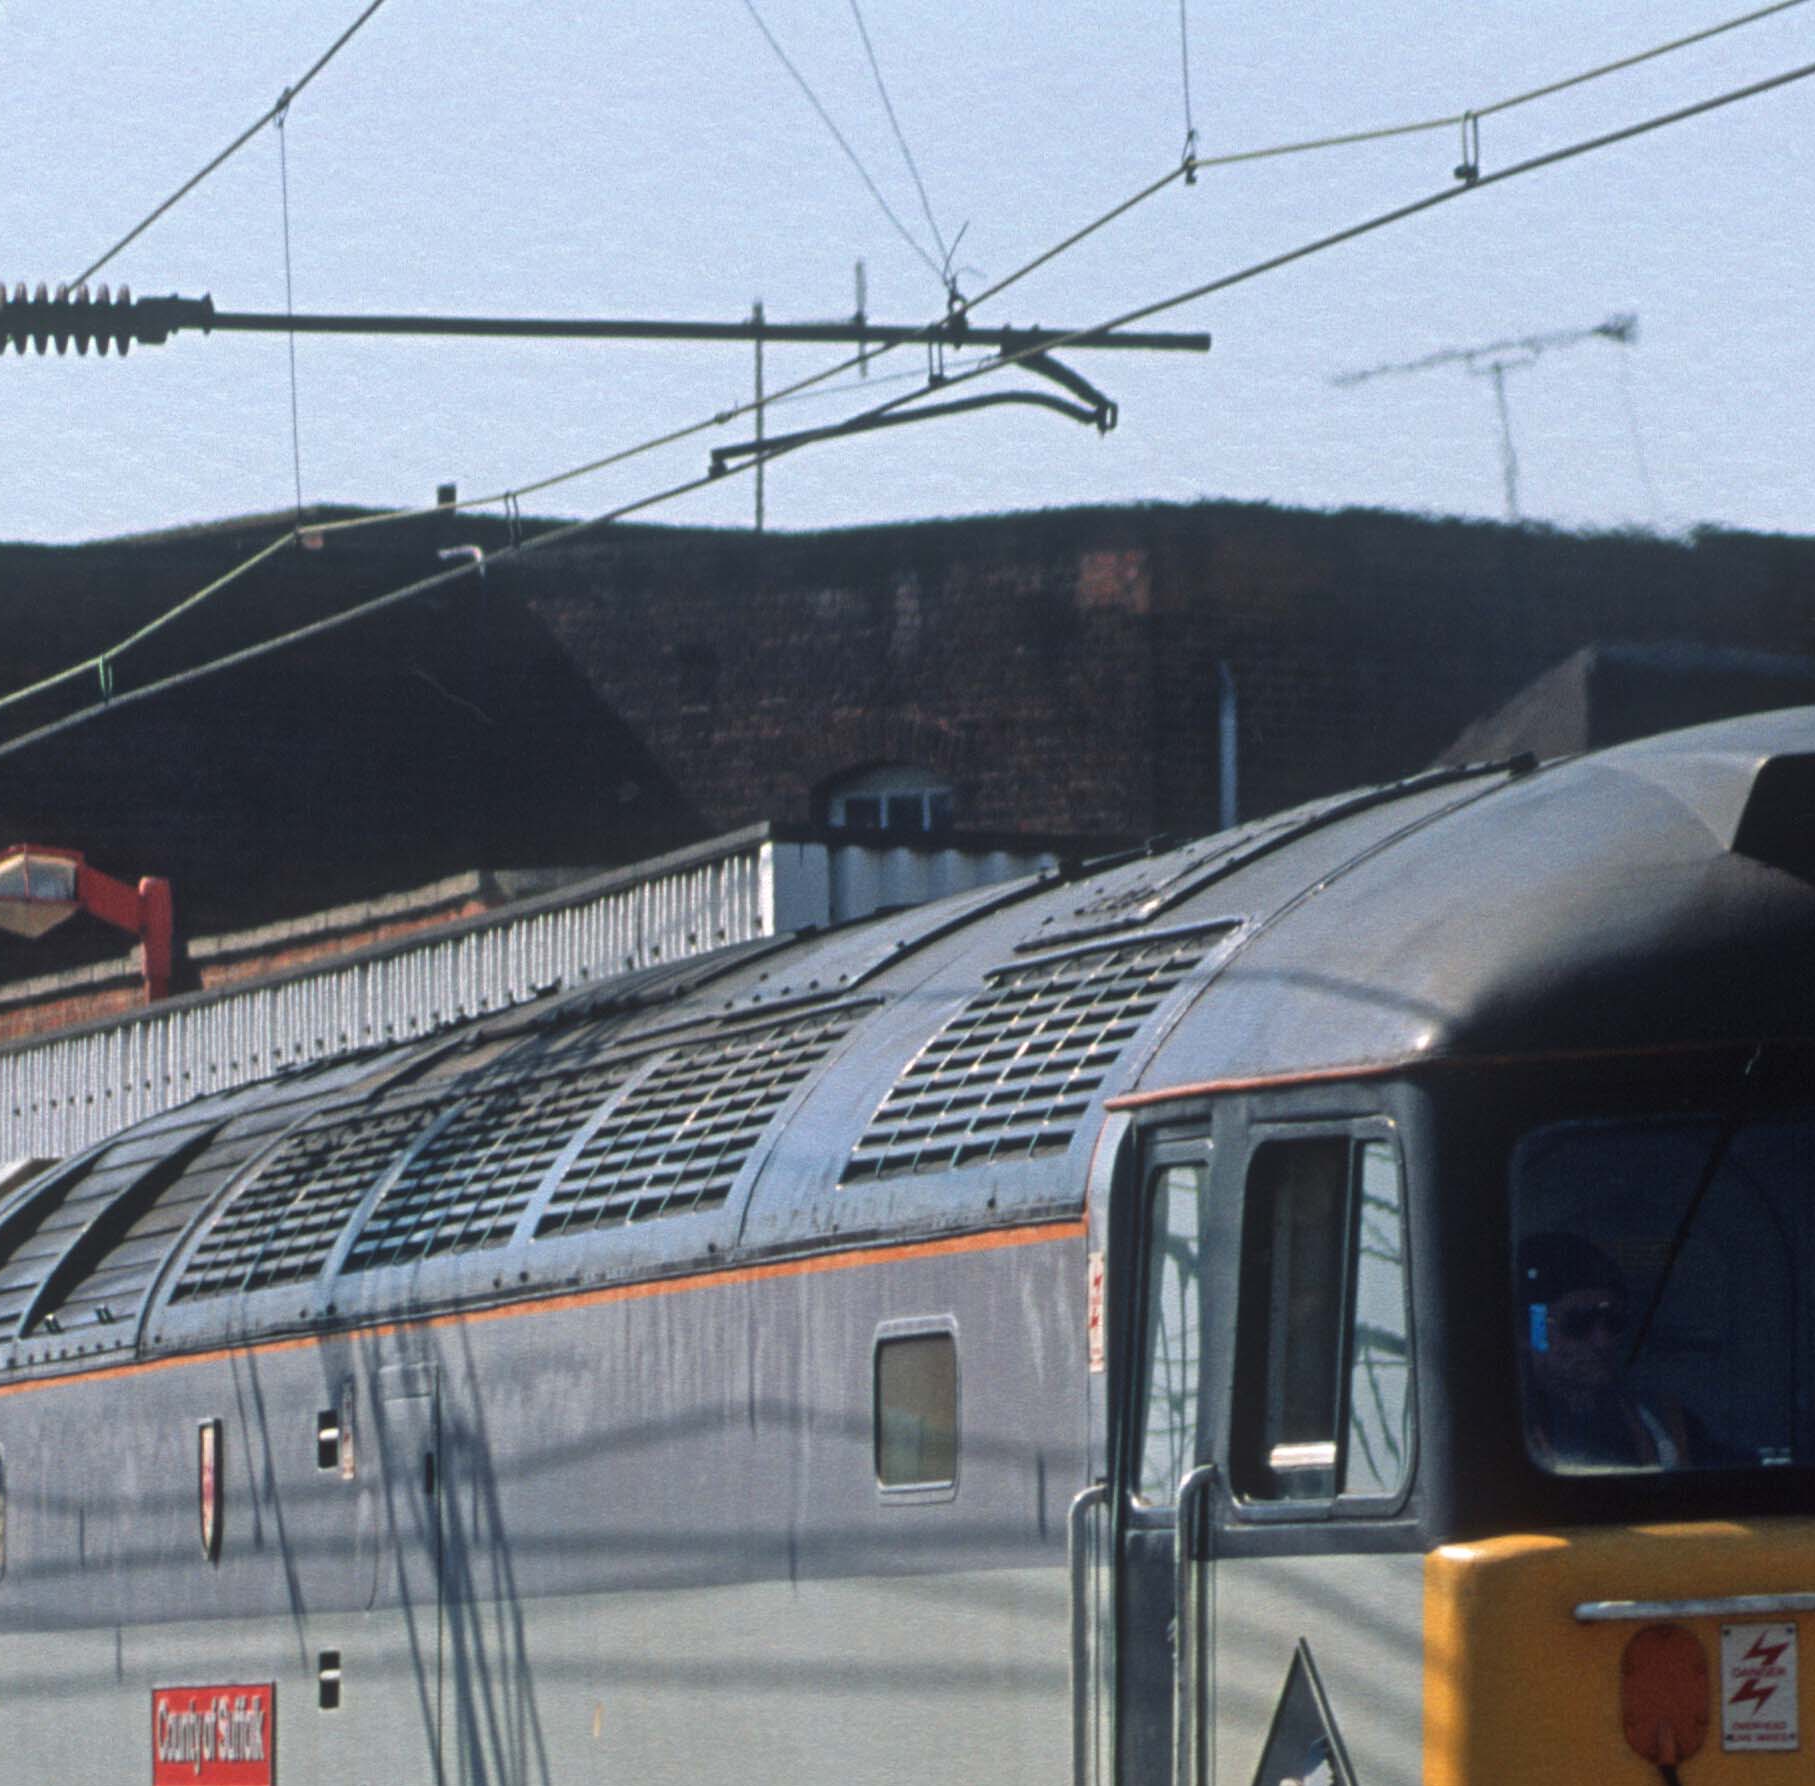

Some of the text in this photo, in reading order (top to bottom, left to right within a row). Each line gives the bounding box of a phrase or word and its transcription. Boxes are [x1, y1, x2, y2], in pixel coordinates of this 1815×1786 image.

[158, 1695, 264, 1776] County of Suffolk
